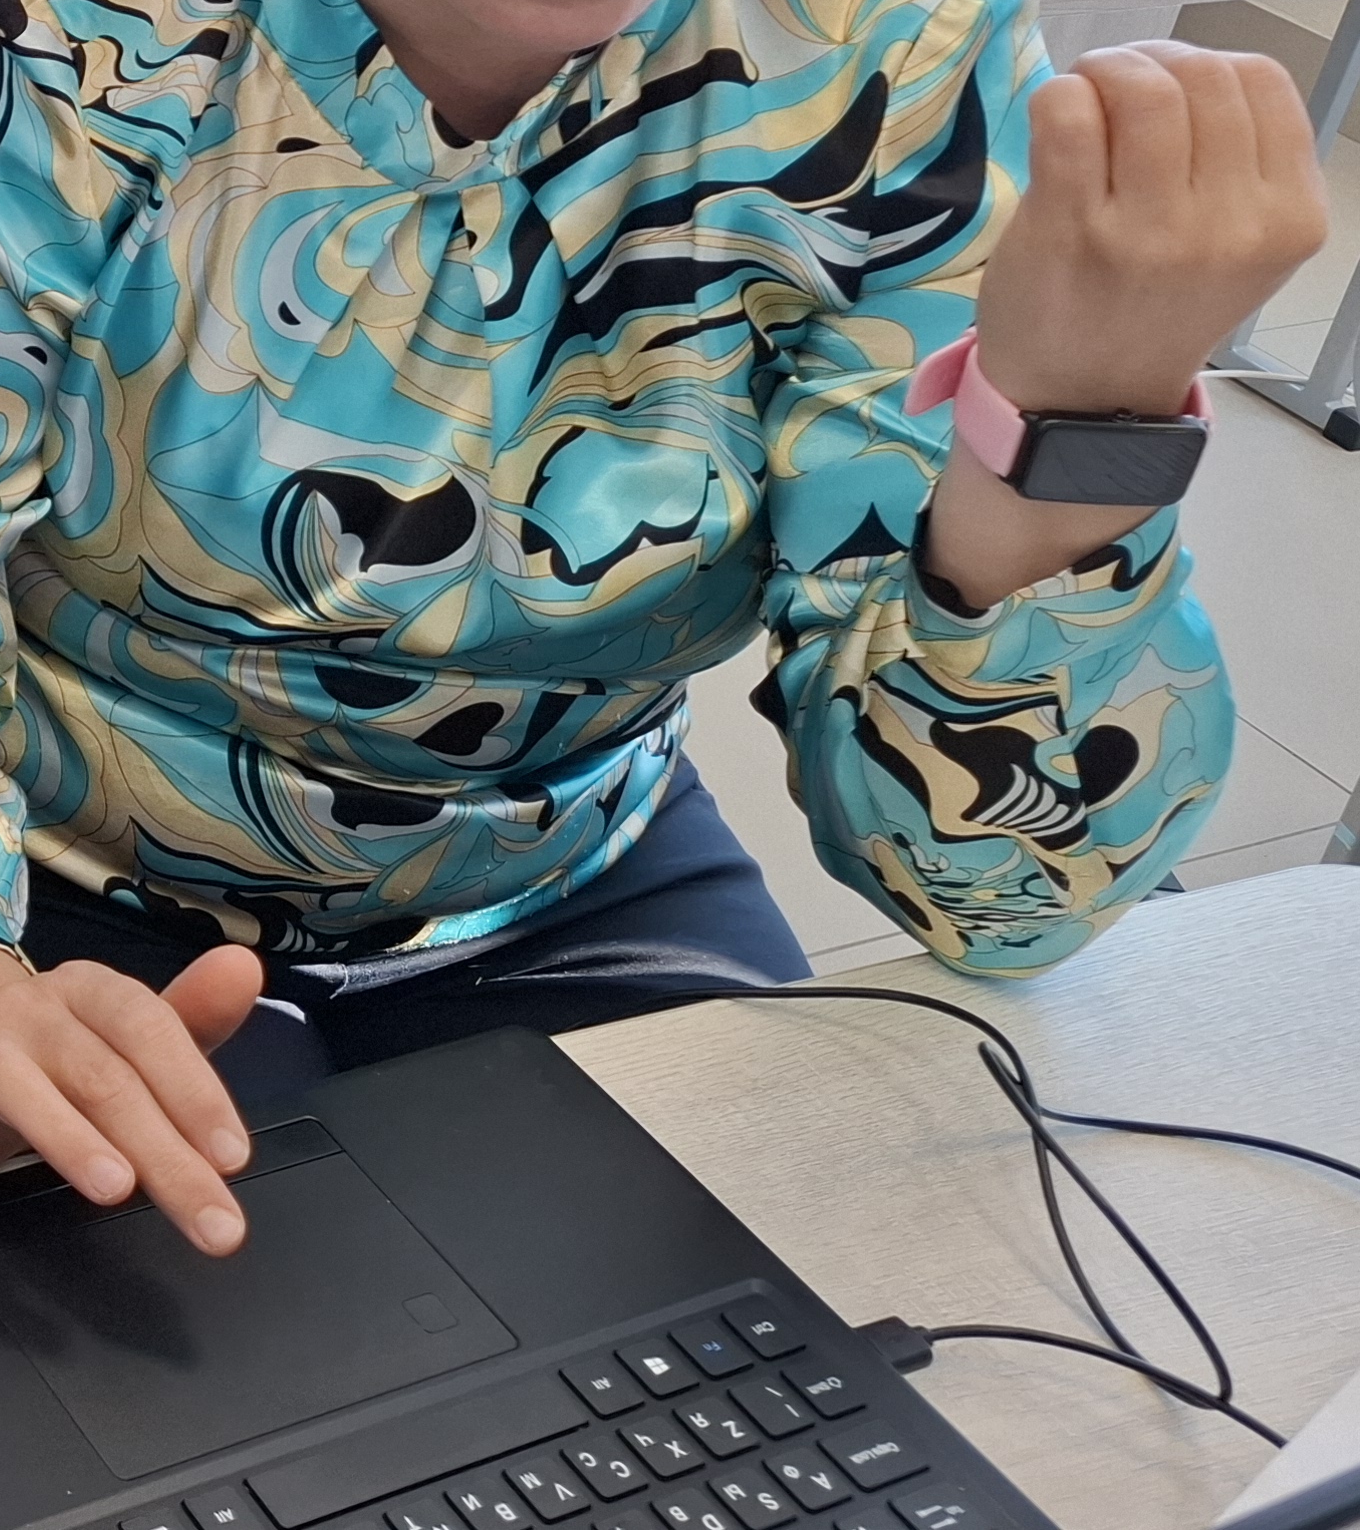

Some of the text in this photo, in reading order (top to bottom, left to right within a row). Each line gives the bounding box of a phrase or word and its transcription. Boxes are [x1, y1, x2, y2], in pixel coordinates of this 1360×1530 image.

[751, 1322, 775, 1335] Ctrl
[703, 1341, 721, 1351] Fn
[591, 1376, 612, 1390] Alt
[690, 1413, 709, 1428] Я
[722, 1421, 745, 1438] Z
[634, 1434, 654, 1446] Ч
[664, 1441, 687, 1458] X
[810, 1473, 832, 1490] A
[555, 1483, 575, 1500] V
[462, 1494, 482, 1510] И
[758, 1493, 779, 1510] S
